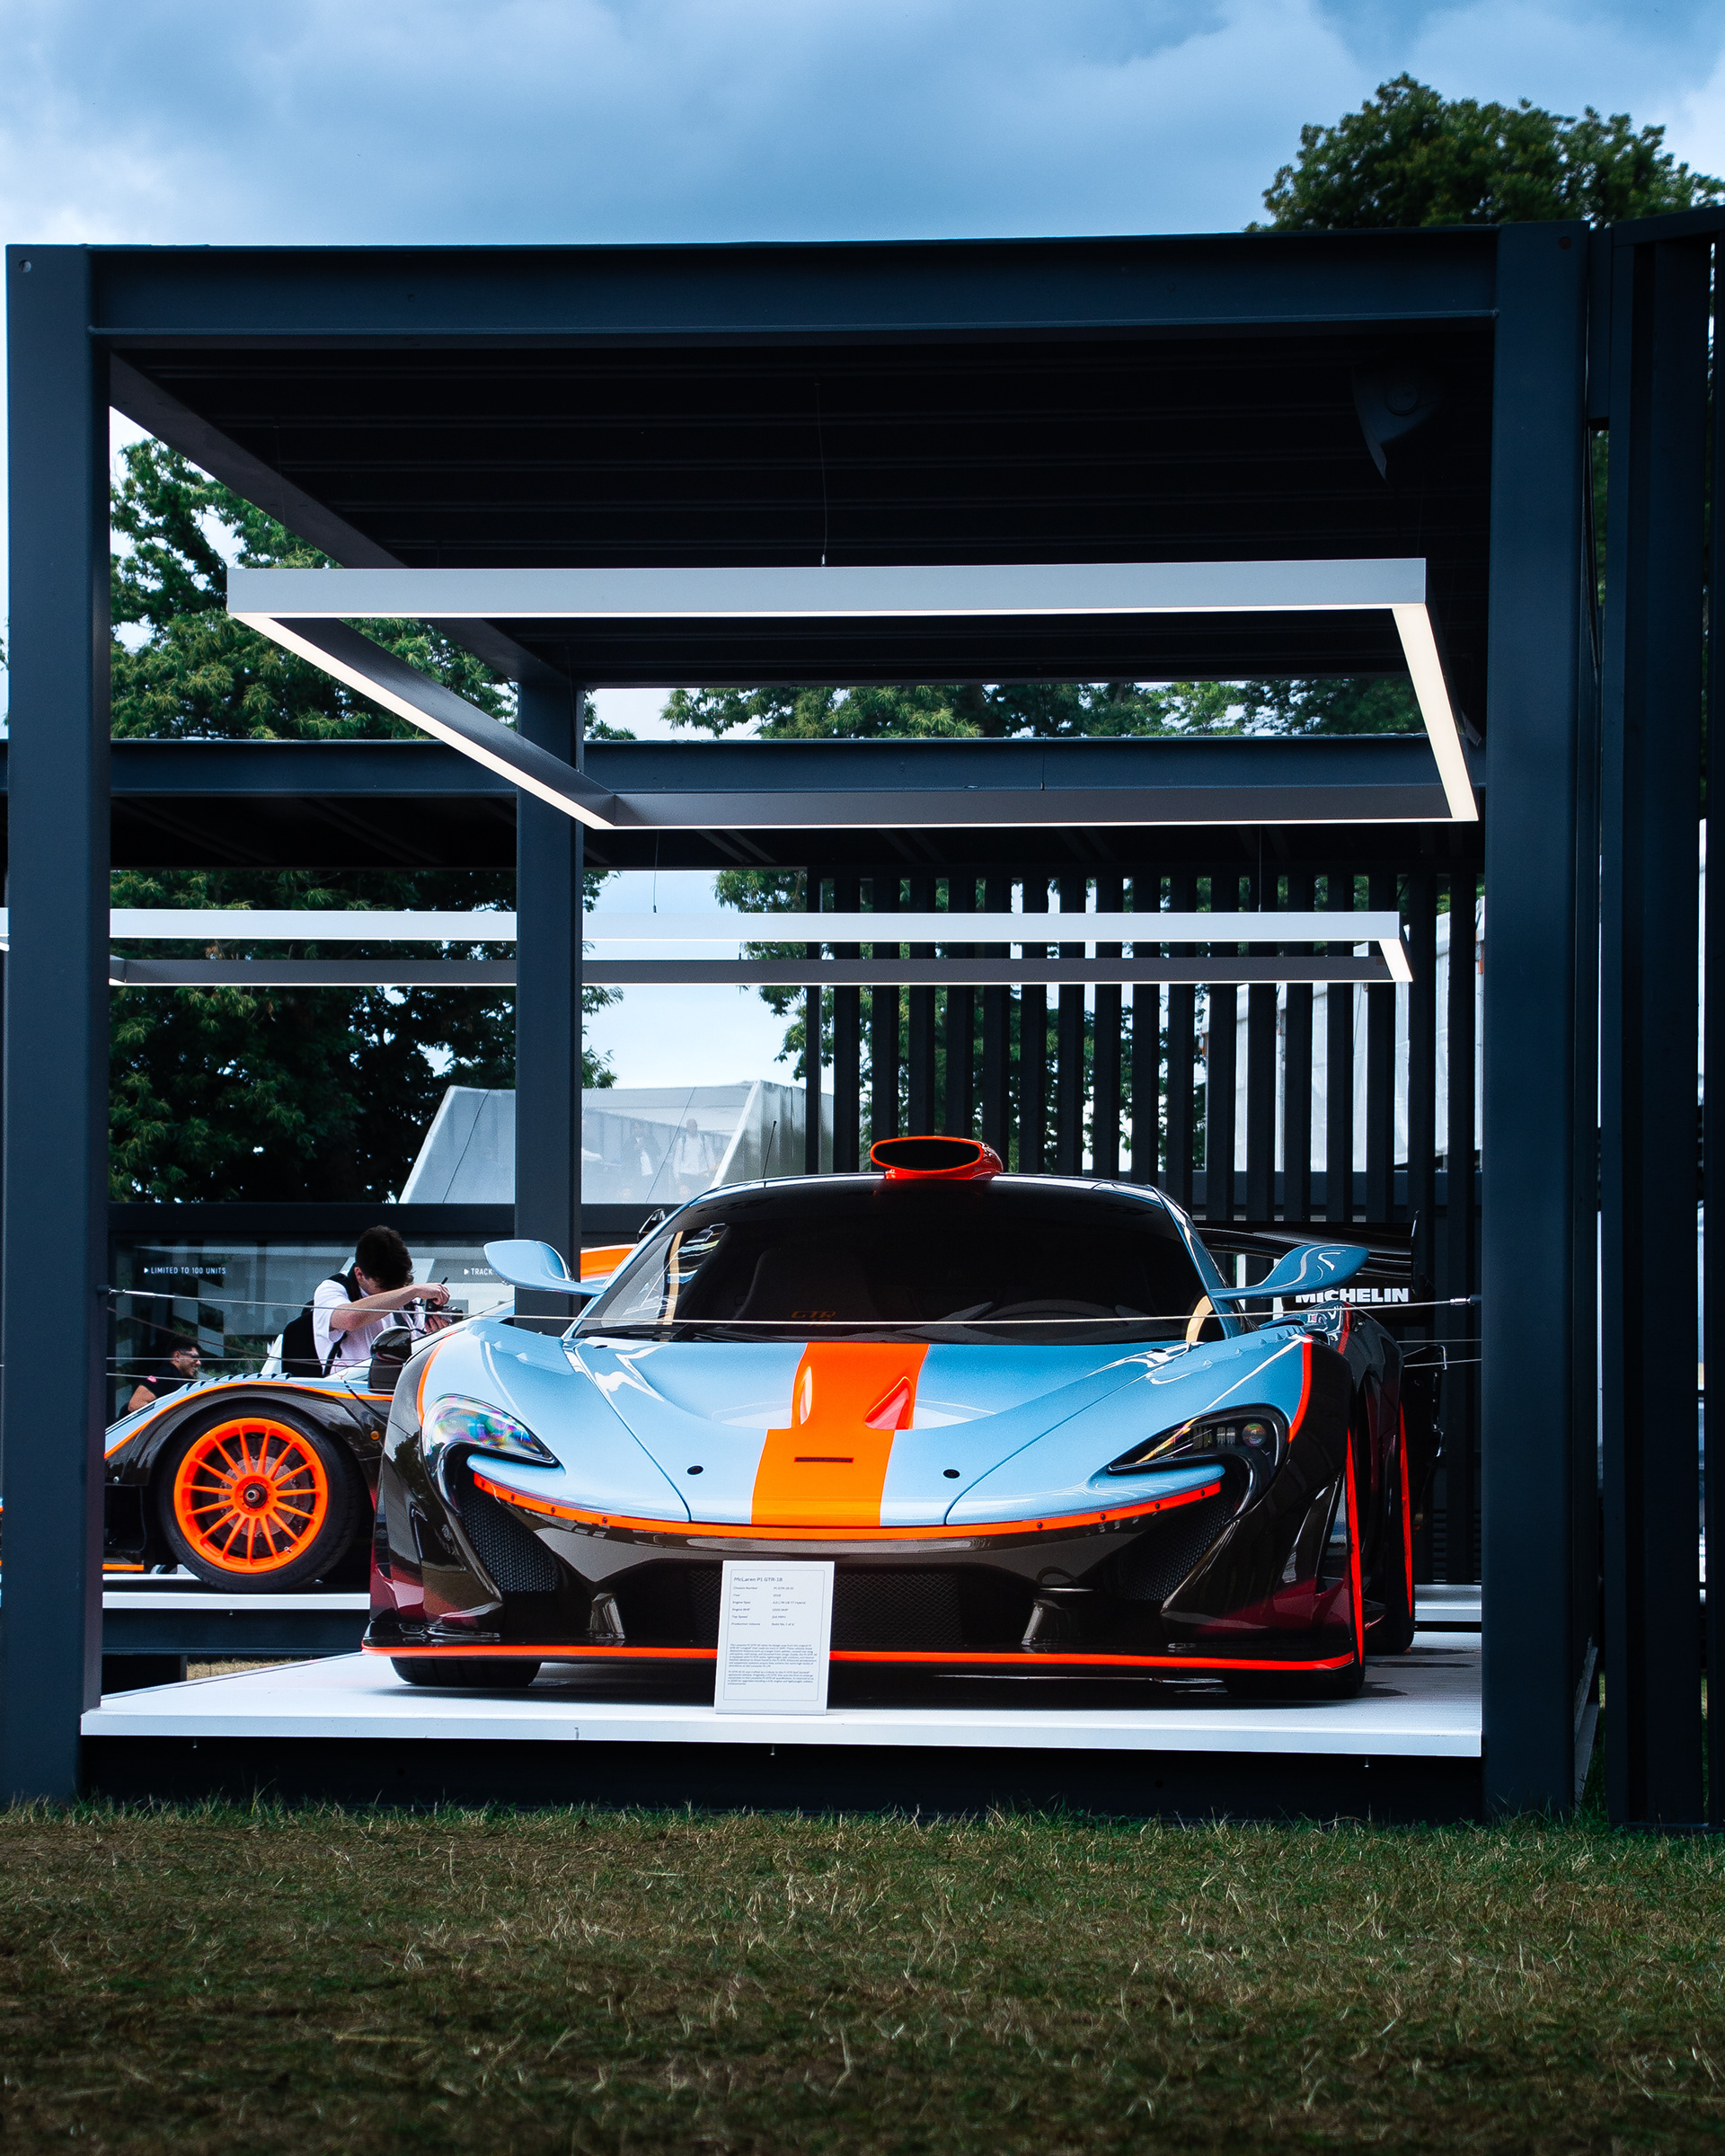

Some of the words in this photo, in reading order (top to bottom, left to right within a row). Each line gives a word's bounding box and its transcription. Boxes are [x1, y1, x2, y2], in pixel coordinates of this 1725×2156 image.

[150, 1267, 179, 1275] LIMITED
[181, 1267, 190, 1275] TO
[191, 1267, 203, 1275] 100
[205, 1267, 226, 1275] UNITS
[470, 1268, 493, 1276] TRACK
[1295, 1288, 1409, 1303] MICHELIN
[791, 1310, 836, 1319] GTR
